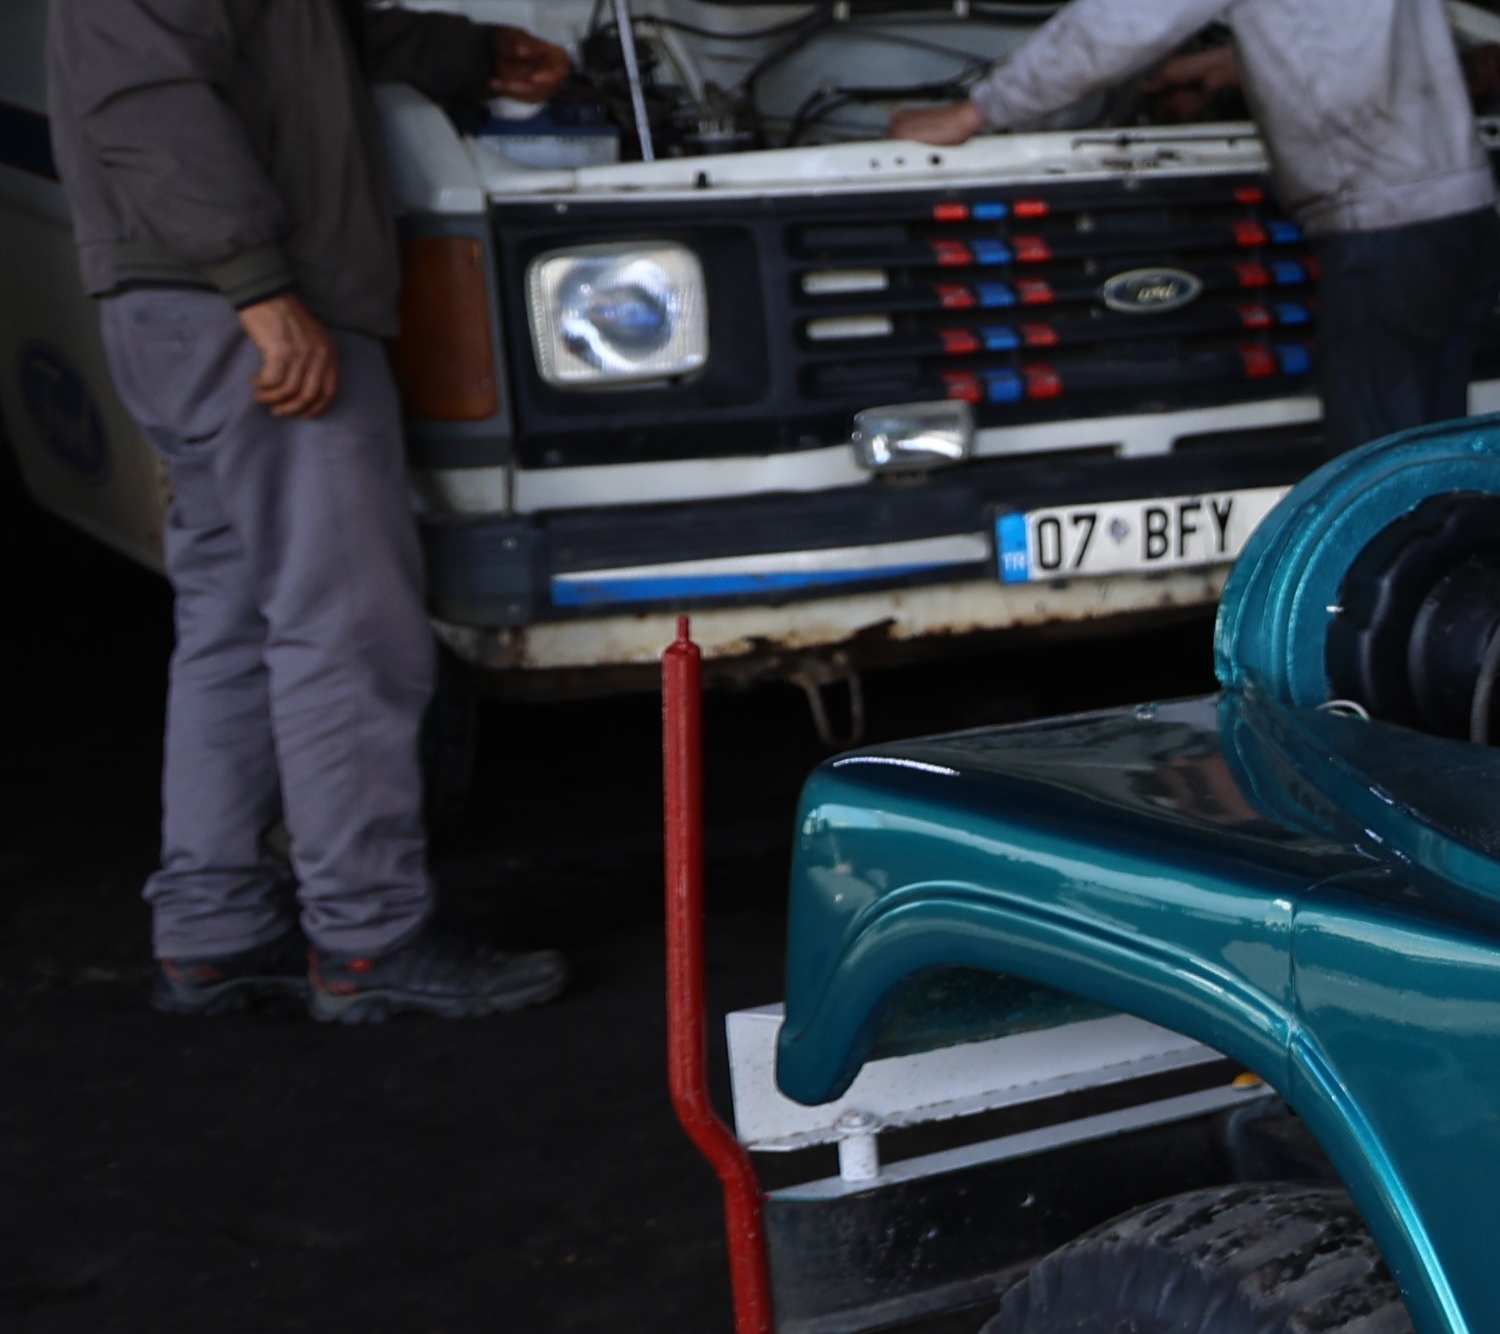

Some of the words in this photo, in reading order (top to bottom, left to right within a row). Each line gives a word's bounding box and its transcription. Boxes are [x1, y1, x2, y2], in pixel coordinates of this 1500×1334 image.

[1035, 512, 1097, 572] 07
[1145, 497, 1233, 560] BFY
[1001, 551, 1026, 572] TR
